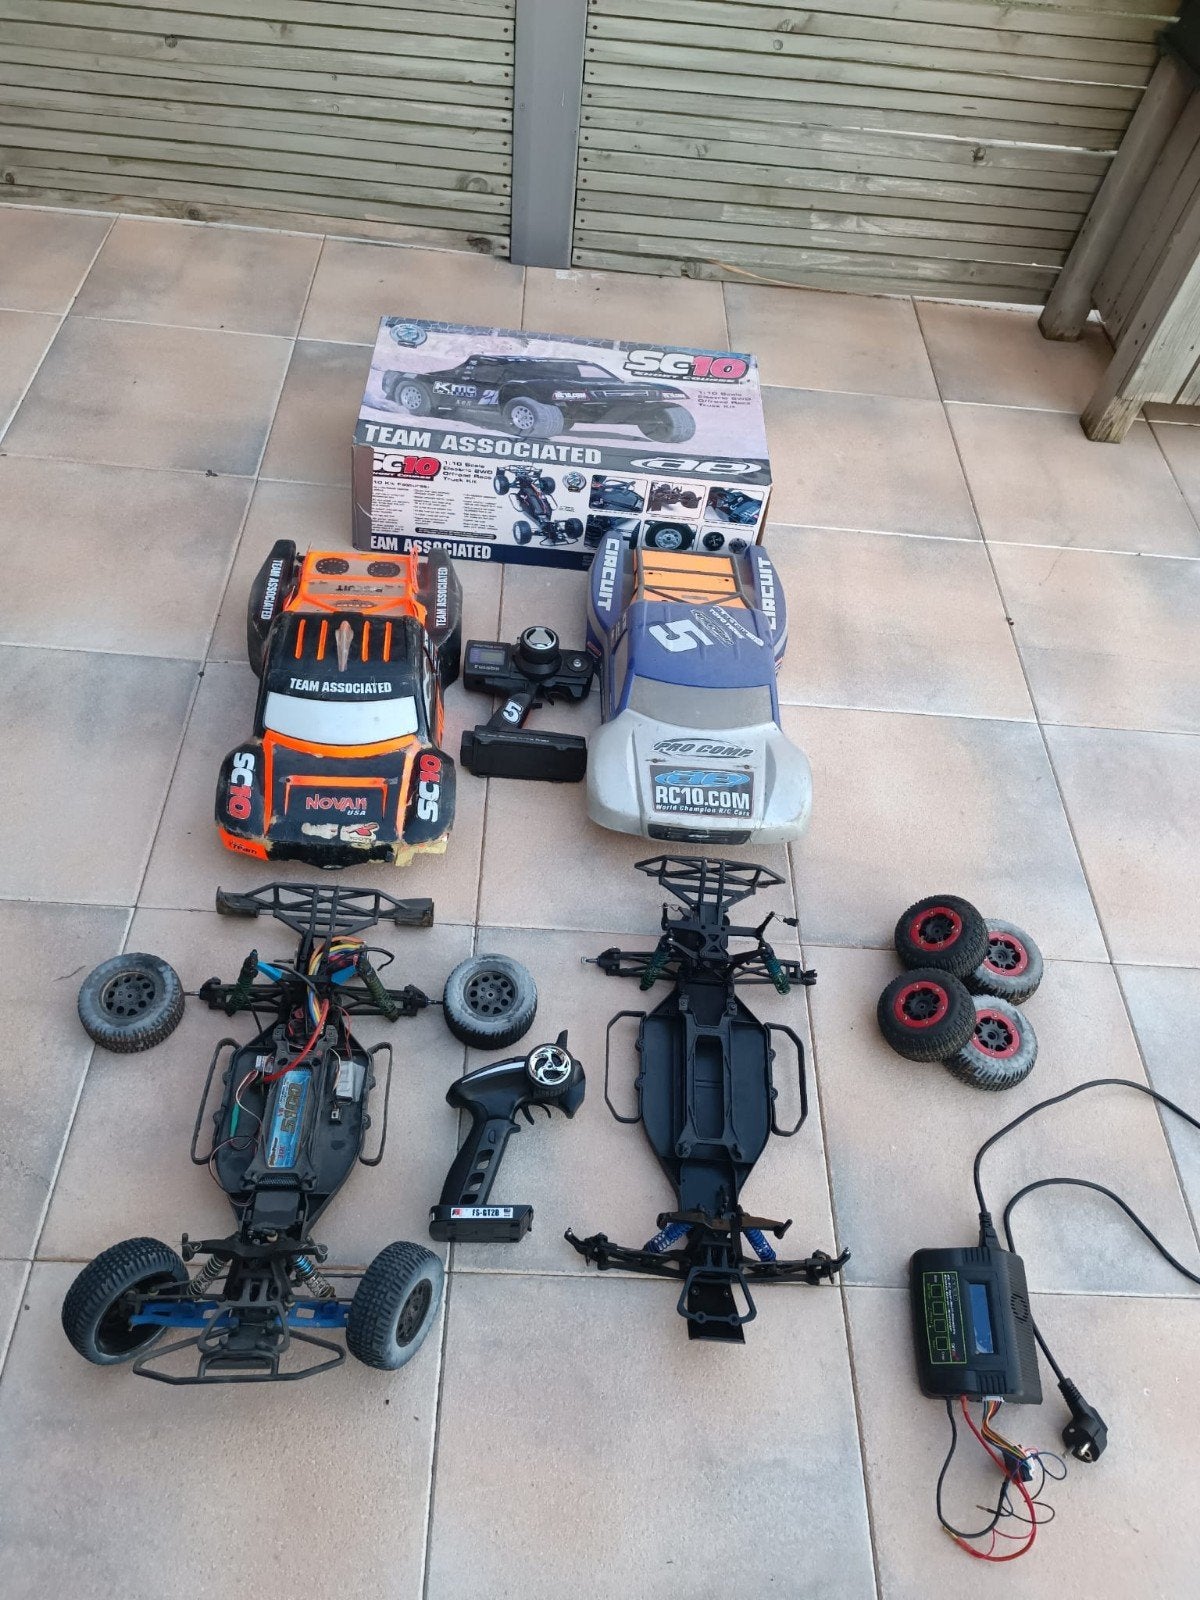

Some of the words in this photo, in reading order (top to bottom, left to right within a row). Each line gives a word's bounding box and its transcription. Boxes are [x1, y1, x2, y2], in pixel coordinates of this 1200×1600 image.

[624, 350, 748, 378] SC10
[365, 424, 431, 448] TEAM
[440, 435, 602, 465] ASSOCIATED
[270, 560, 283, 577] TEAM
[597, 538, 619, 611] CIRCUIT
[261, 578, 279, 620] ASSOCIATED
[437, 567, 448, 610] ASSOCIATED
[436, 611, 447, 626] TEAM
[648, 619, 714, 652] 5
[290, 678, 319, 692] TEAM
[321, 682, 392, 693] ASSOCIATED
[503, 700, 523, 723] 5
[654, 742, 695, 753] PRO
[696, 745, 754, 757] COMP
[229, 752, 255, 819] SC10
[417, 754, 441, 823] SC10
[655, 786, 750, 810] RC10.COM
[680, 805, 716, 814] Champion
[733, 809, 750, 817] Cars
